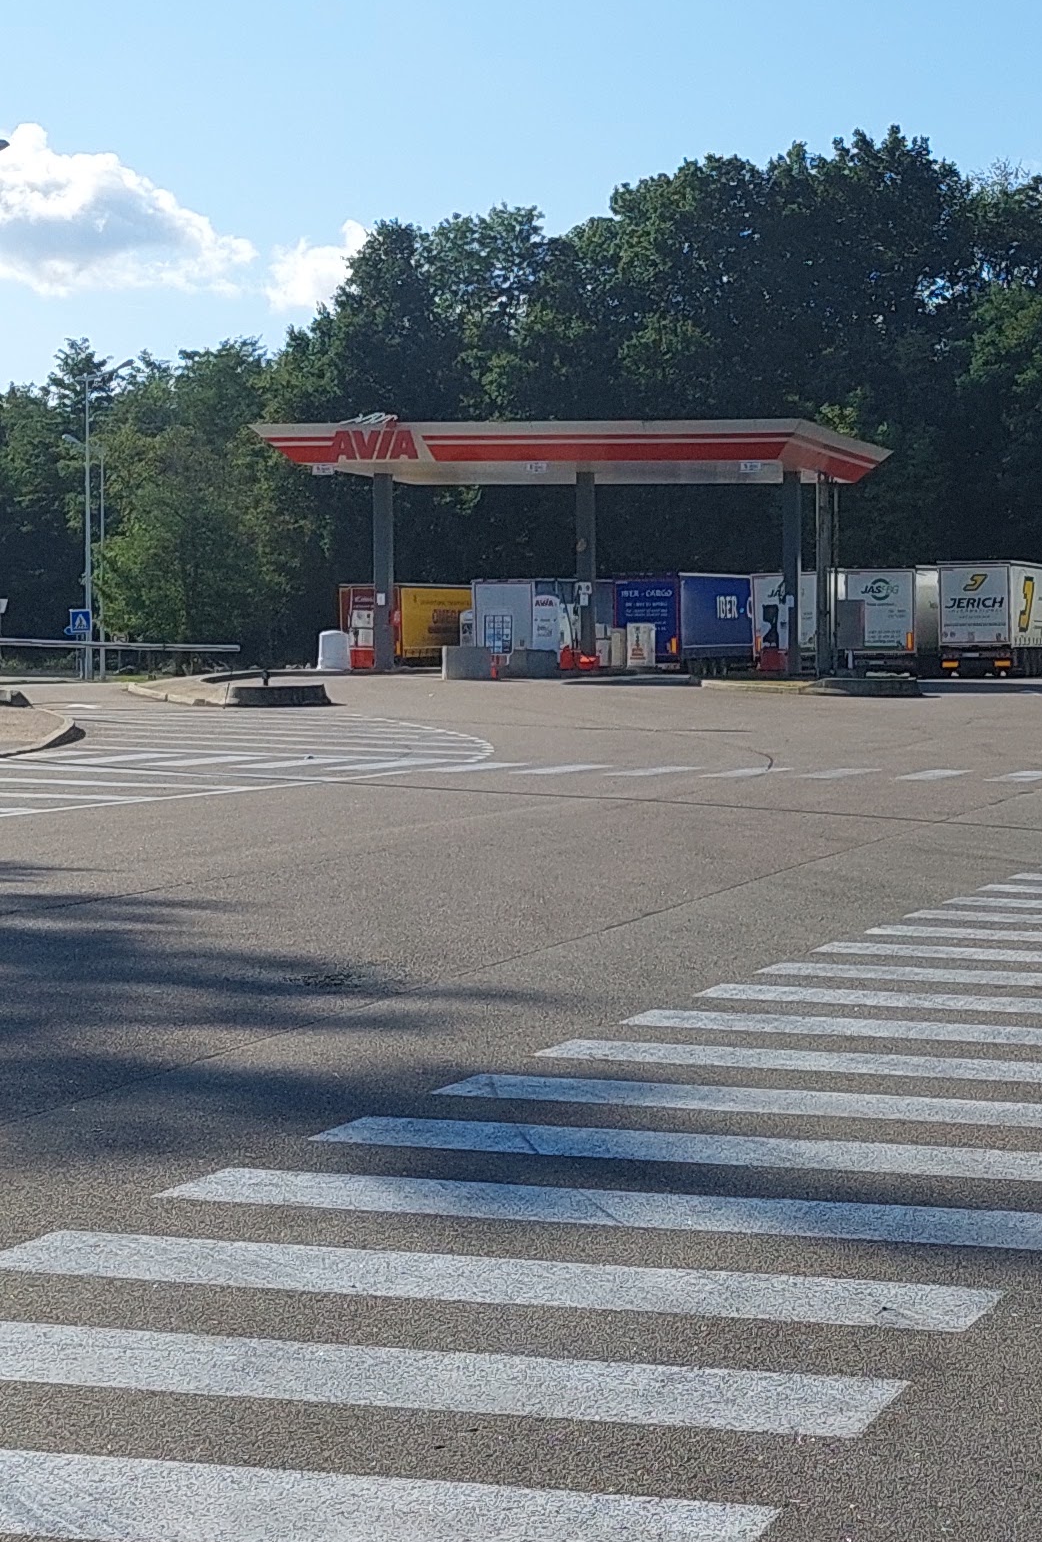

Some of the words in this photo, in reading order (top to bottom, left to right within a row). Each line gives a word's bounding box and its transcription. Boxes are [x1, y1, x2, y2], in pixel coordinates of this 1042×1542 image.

[331, 423, 419, 460] AVIA
[716, 595, 738, 619] IBER
[944, 596, 1005, 609] JERICH
